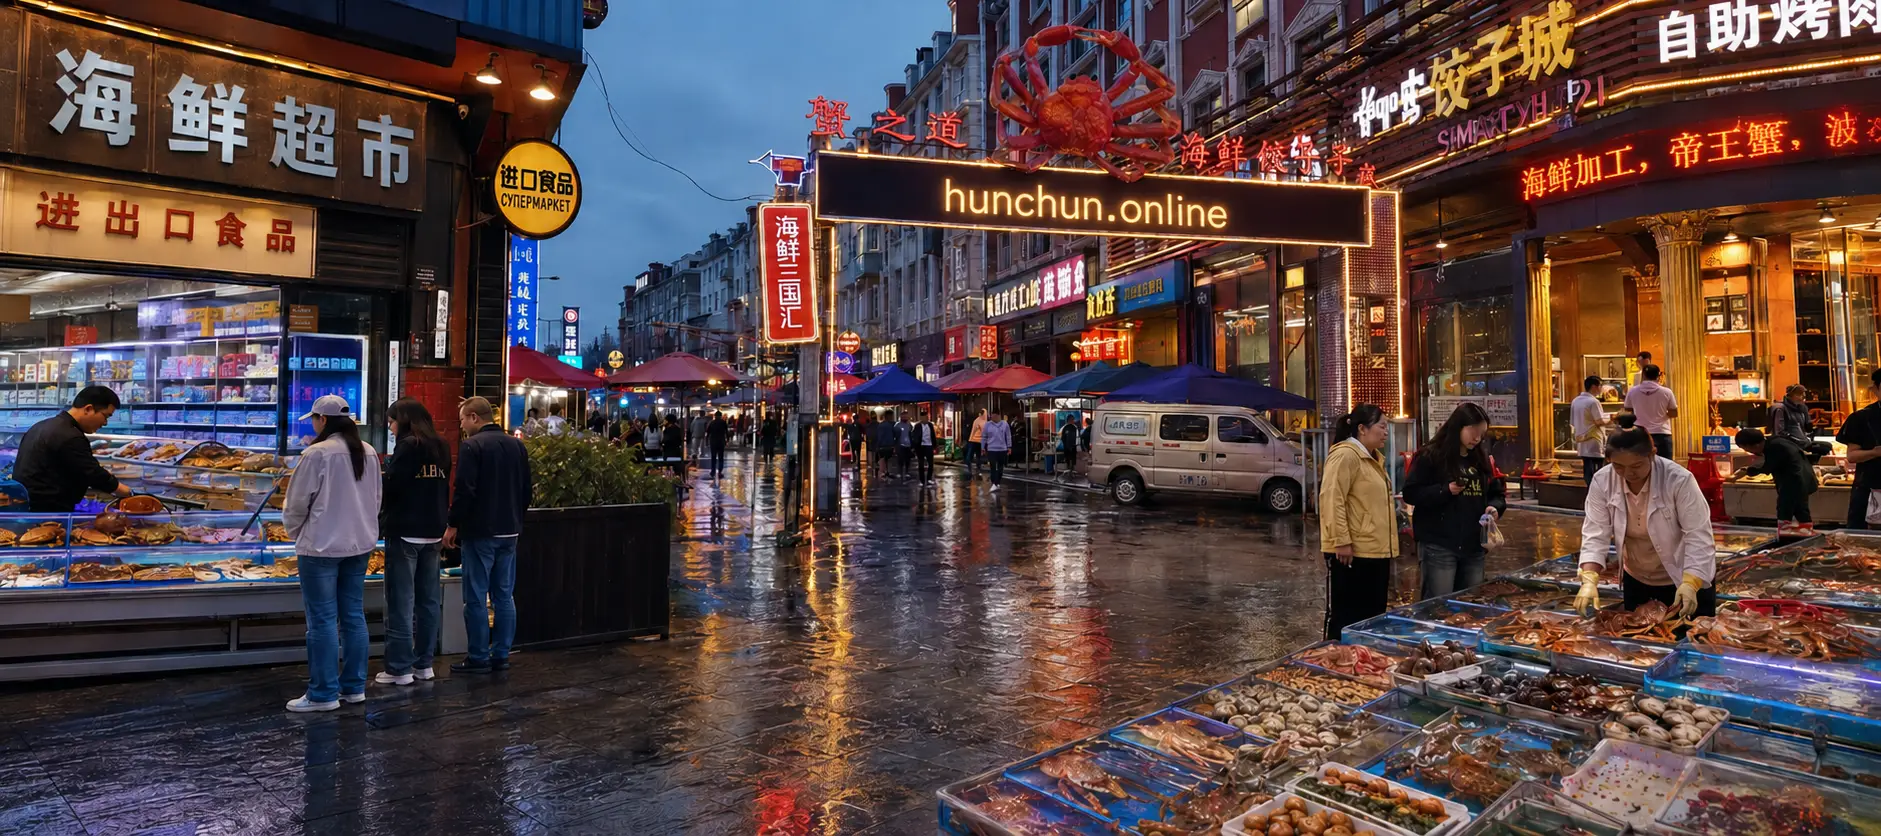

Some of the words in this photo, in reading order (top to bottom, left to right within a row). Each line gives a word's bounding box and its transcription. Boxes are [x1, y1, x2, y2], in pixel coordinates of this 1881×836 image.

[49, 48, 415, 188] 海鲜超市
[805, 95, 969, 149] 蟹之道
[500, 164, 574, 196] 进口食品
[500, 193, 572, 213] СУПЕРМАРКЕТ
[944, 178, 1228, 229] hunchun.online
[36, 191, 296, 253] 进出口食品
[775, 215, 803, 329] 海鲜三国汇
